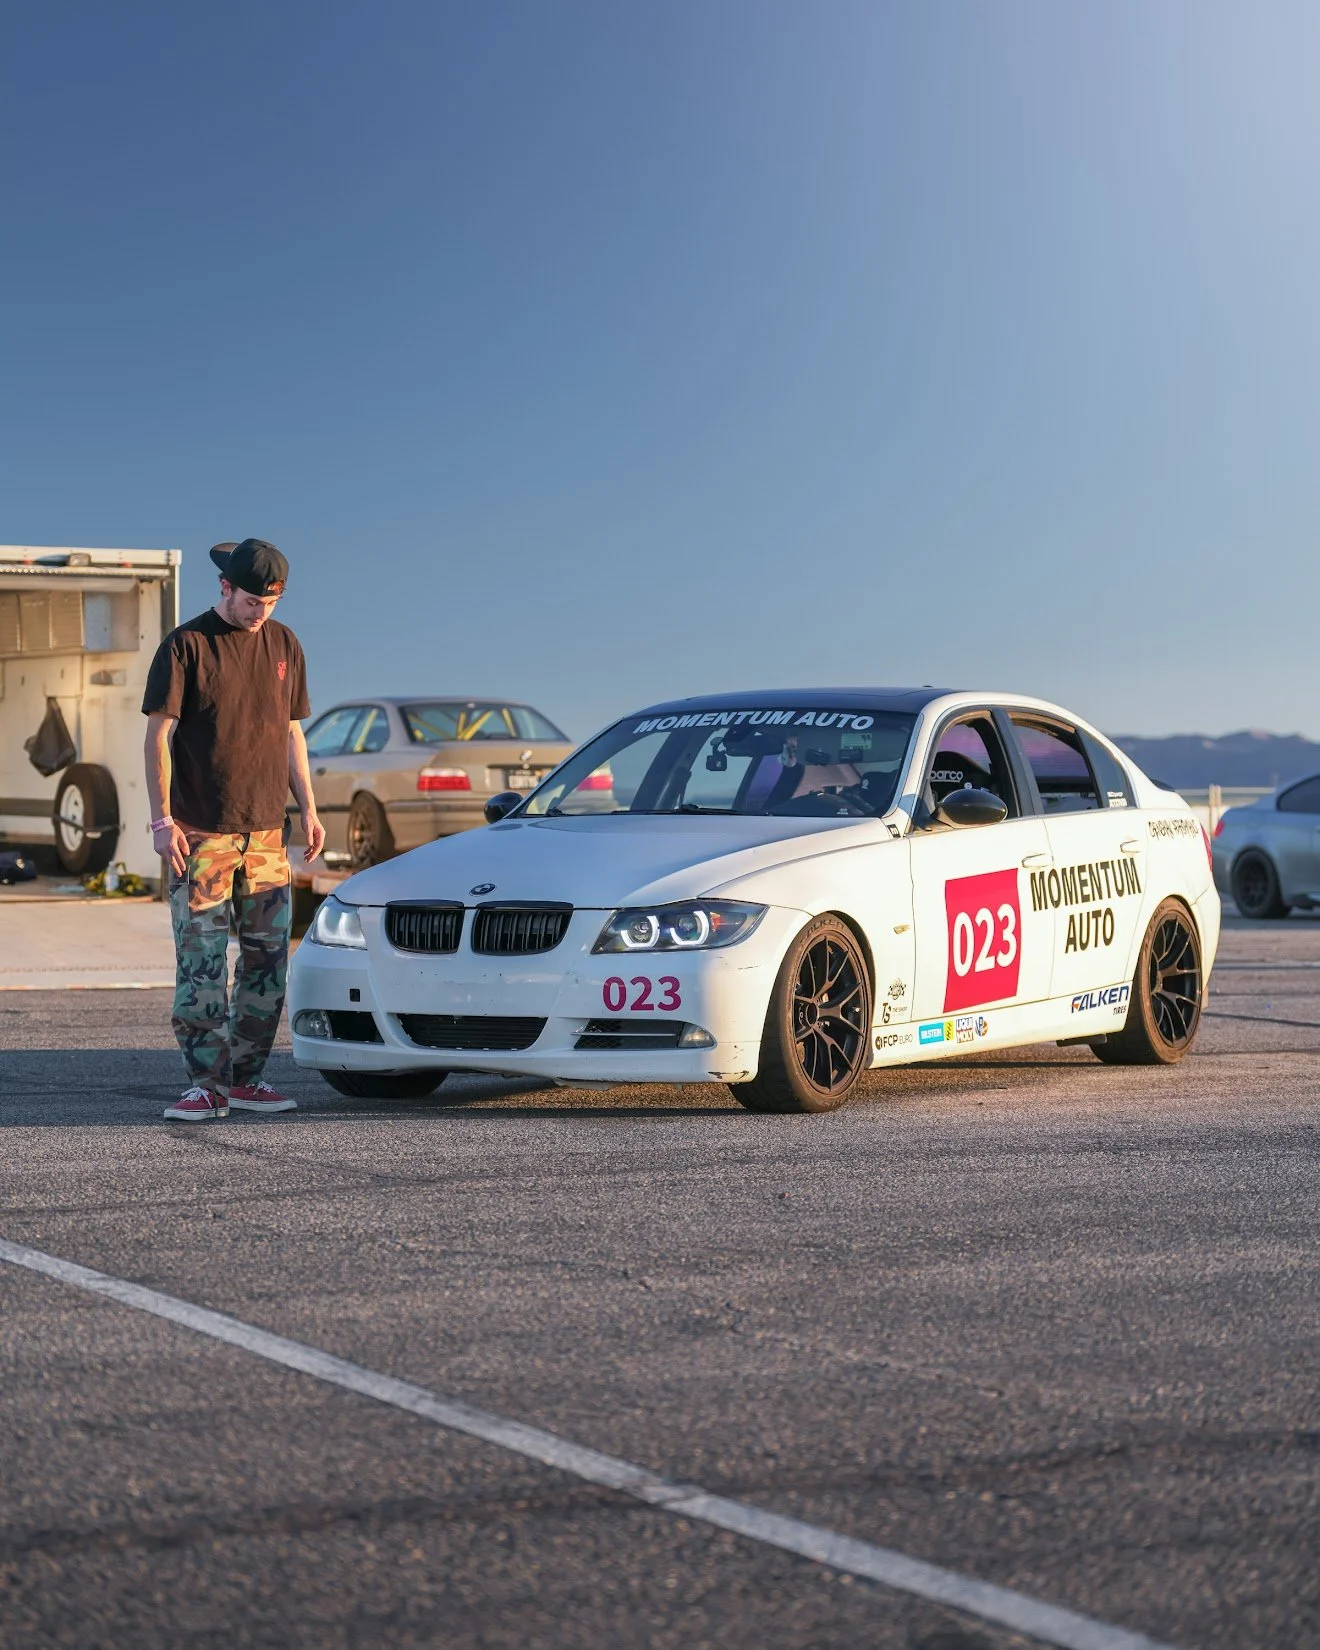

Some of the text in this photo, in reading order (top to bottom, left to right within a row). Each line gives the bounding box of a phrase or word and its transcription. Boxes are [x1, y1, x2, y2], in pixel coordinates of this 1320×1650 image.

[632, 710, 875, 734] MOMENTUM AUTO
[930, 770, 964, 780] parco
[1030, 857, 1142, 912] MOMENTUM
[953, 903, 1016, 977] 023
[1065, 907, 1115, 954] AUTO
[602, 975, 682, 1011] 023
[1071, 985, 1129, 1013] FALKEN
[1112, 1005, 1127, 1015] TIRES
[883, 1034, 898, 1047] FCP
